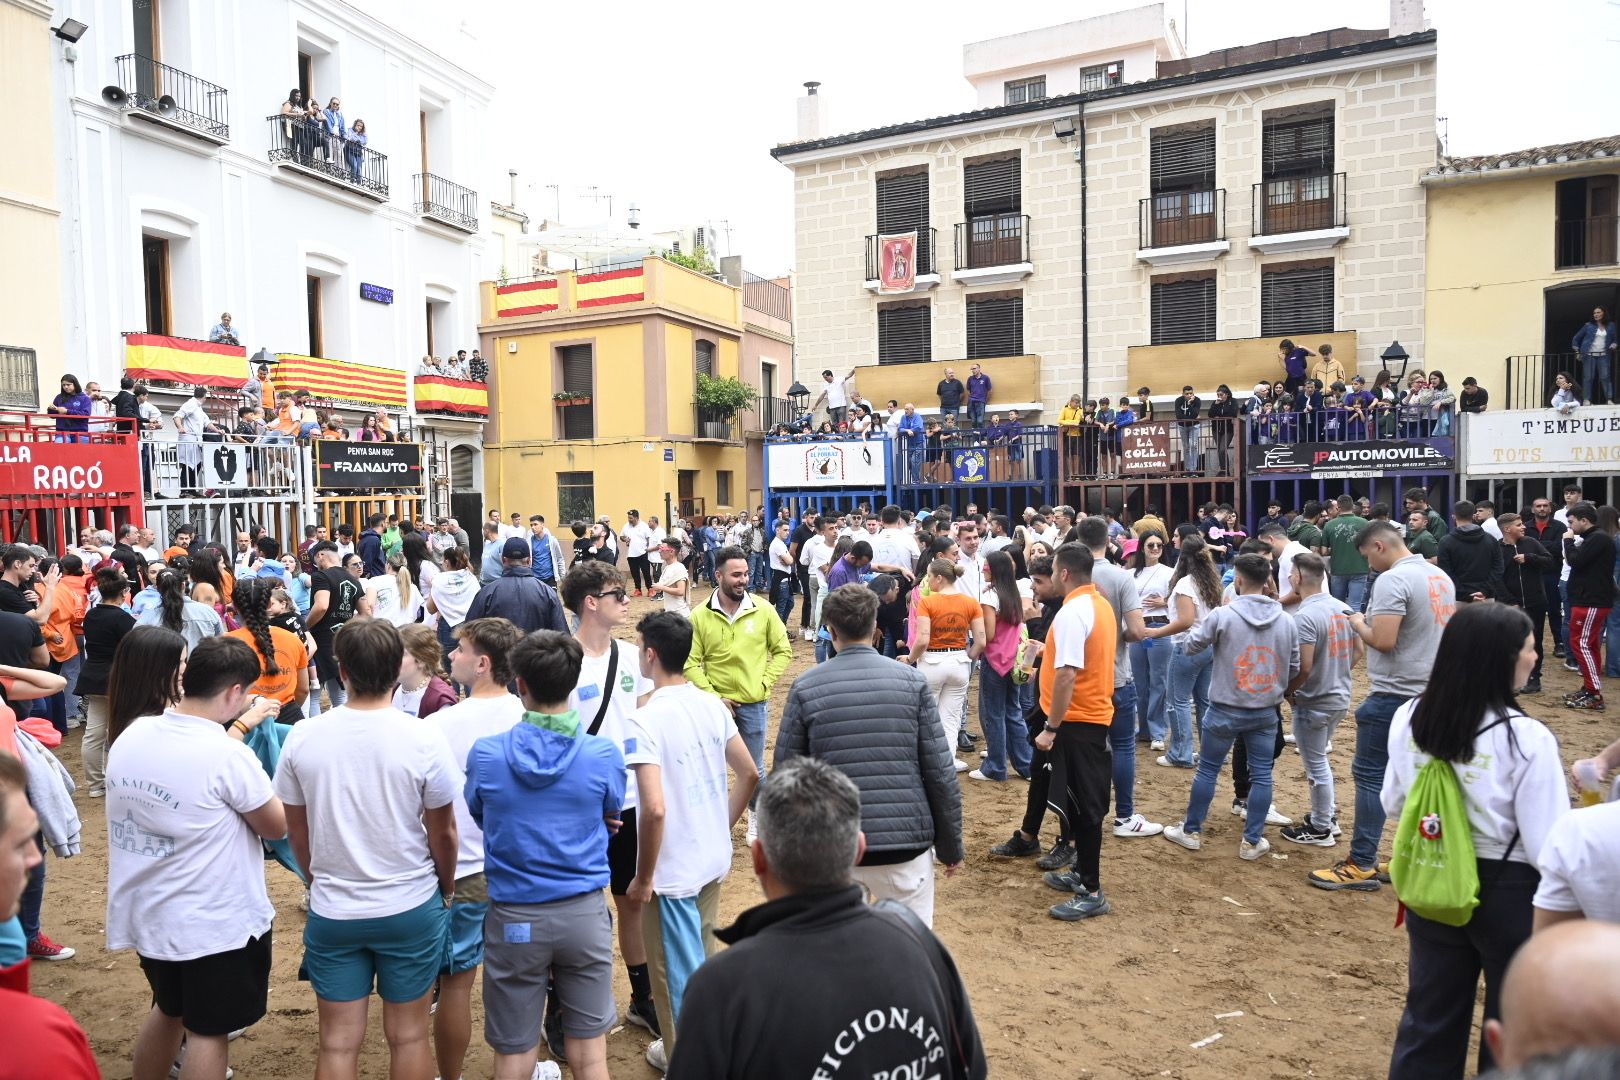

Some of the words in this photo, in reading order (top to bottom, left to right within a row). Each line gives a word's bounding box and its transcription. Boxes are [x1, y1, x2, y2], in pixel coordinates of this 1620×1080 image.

[1124, 426, 1166, 437] PENYA
[1136, 438, 1153, 447] LA
[0, 446, 31, 463] LA
[347, 447, 367, 456] PENYA
[368, 448, 381, 456] SAN
[1124, 448, 1166, 458] COLLA
[1493, 448, 1541, 461] TOTS
[334, 461, 408, 473] FRANAUTO
[33, 461, 102, 490] RACÓ
[122, 777, 179, 809] KALIMBA
